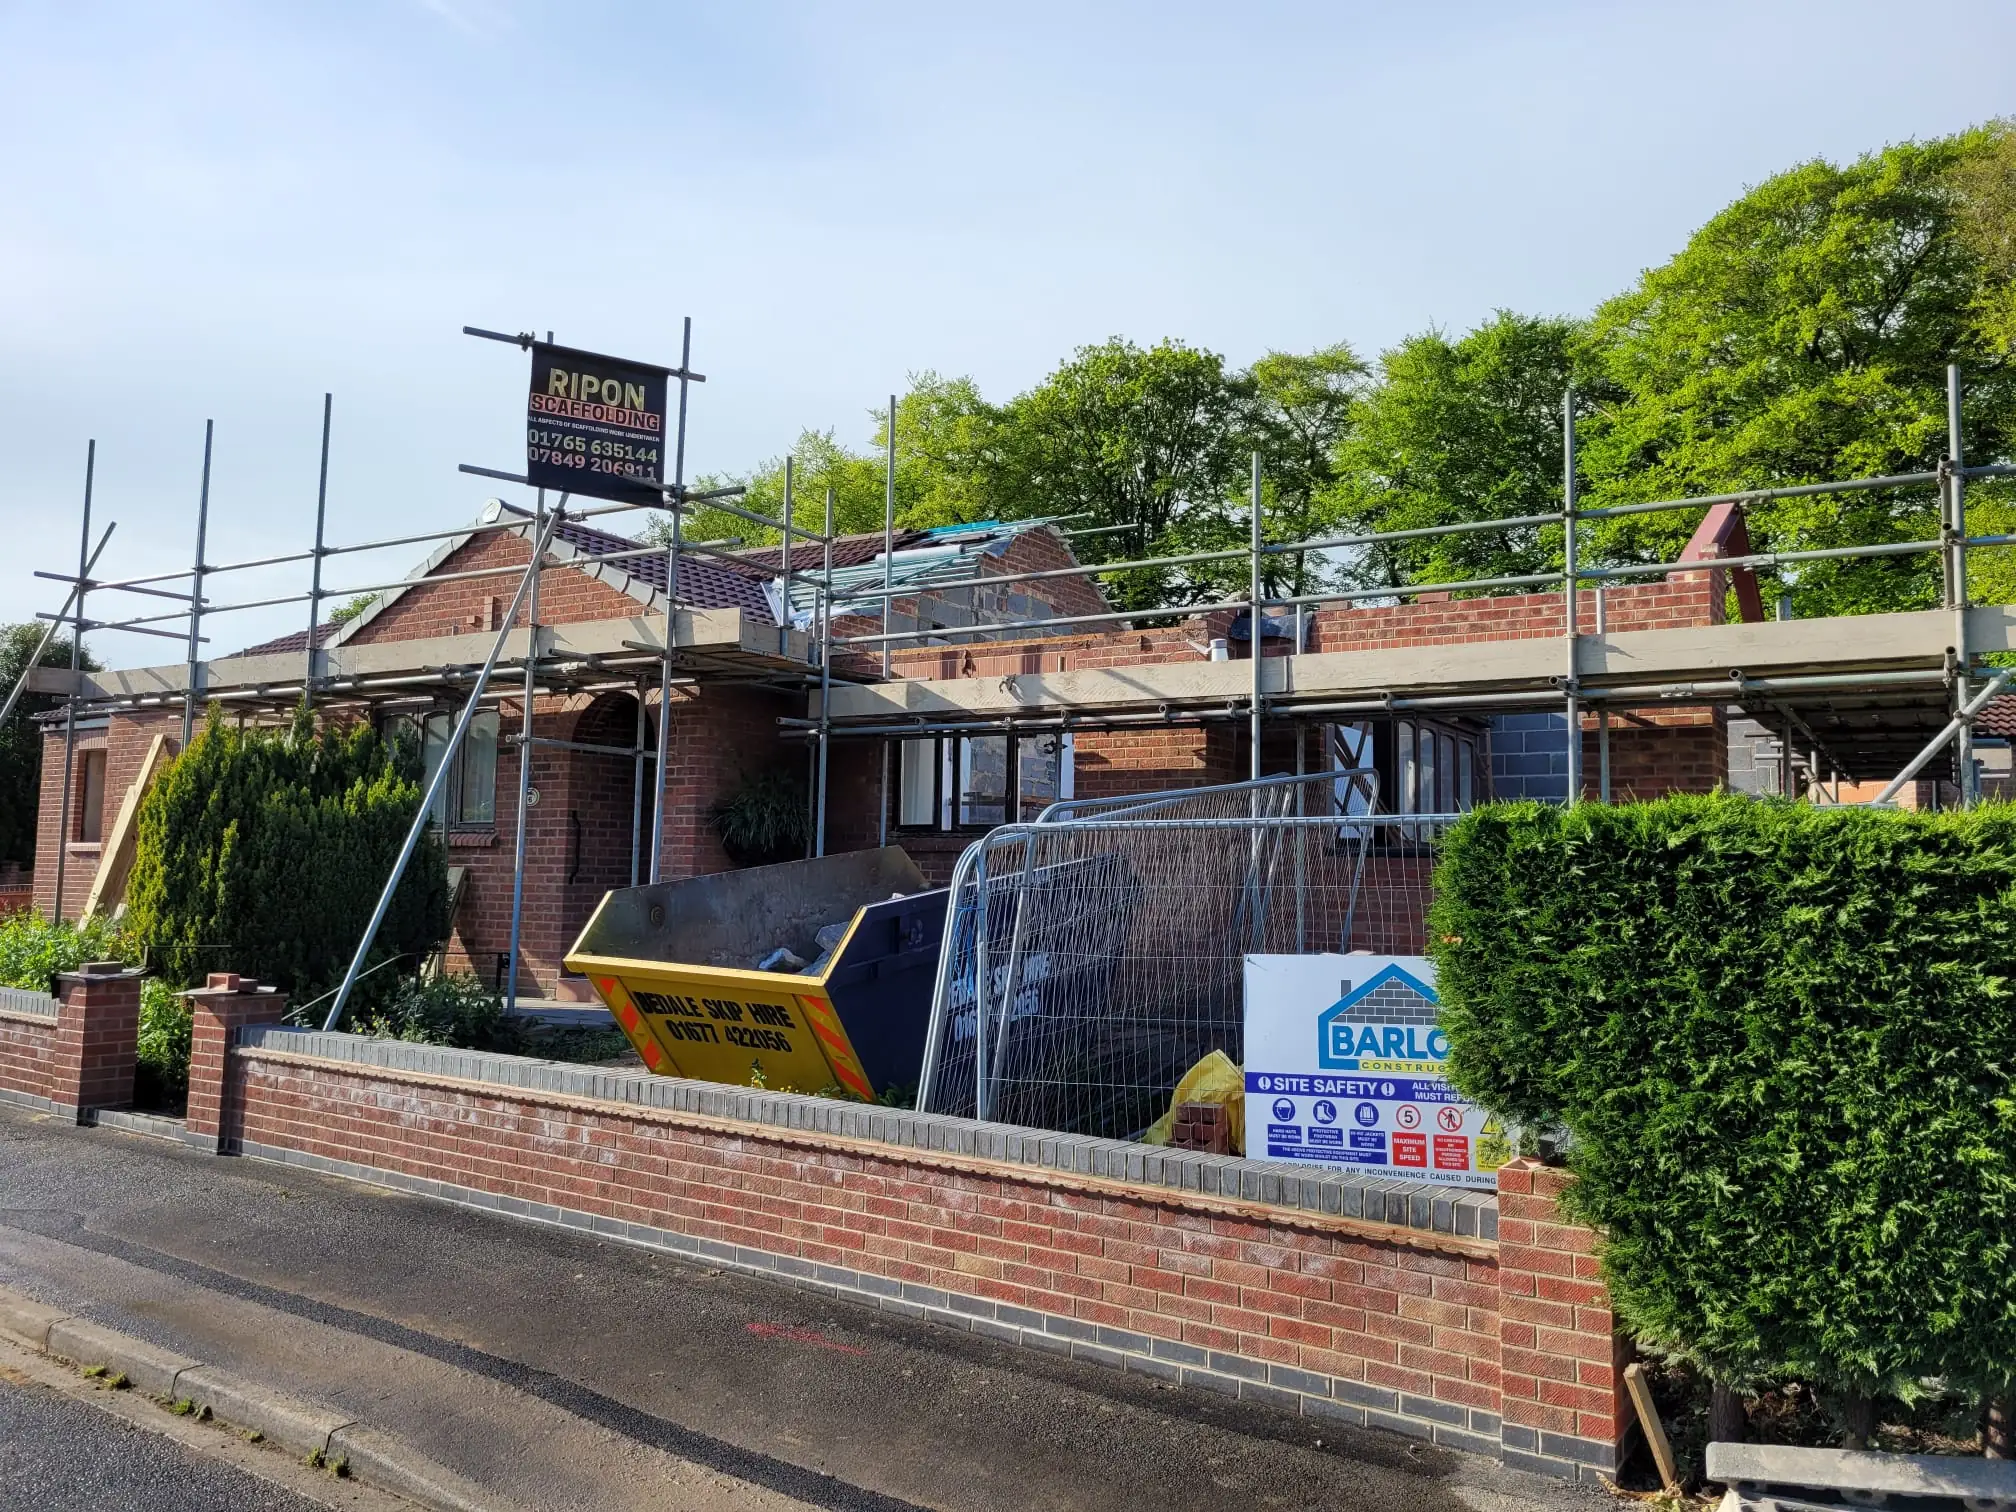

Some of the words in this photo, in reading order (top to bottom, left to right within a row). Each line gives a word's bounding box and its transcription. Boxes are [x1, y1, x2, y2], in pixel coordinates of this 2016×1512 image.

[548, 367, 645, 411] RIPON
[531, 395, 659, 430] SCAFFOLDING
[539, 418, 563, 427] ASPECTS
[572, 423, 608, 434] SCAFFOLDING
[609, 429, 625, 437] WORK
[528, 429, 586, 452] 01765
[590, 440, 657, 464] 635144
[528, 447, 585, 469] 07849
[590, 458, 657, 482] 206911
[632, 991, 705, 1018] BEDALE
[701, 998, 744, 1022] SKIP
[746, 1001, 796, 1029] HIRE
[665, 1019, 720, 1044] 01677
[725, 1025, 792, 1053] 422056
[1332, 1025, 1452, 1060] BARLO
[1361, 1062, 1445, 1073] CONSTRUC
[1274, 1077, 1309, 1093] SITE
[1313, 1078, 1378, 1096] SAFETY
[1412, 1082, 1429, 1091] ALL
[1415, 1092, 1442, 1101] MUST
[1404, 1110, 1413, 1123] 5
[1364, 1168, 1426, 1179] INCONVENIENCE
[1430, 1173, 1461, 1182] CAUSED
[1466, 1175, 1496, 1185] DURING
